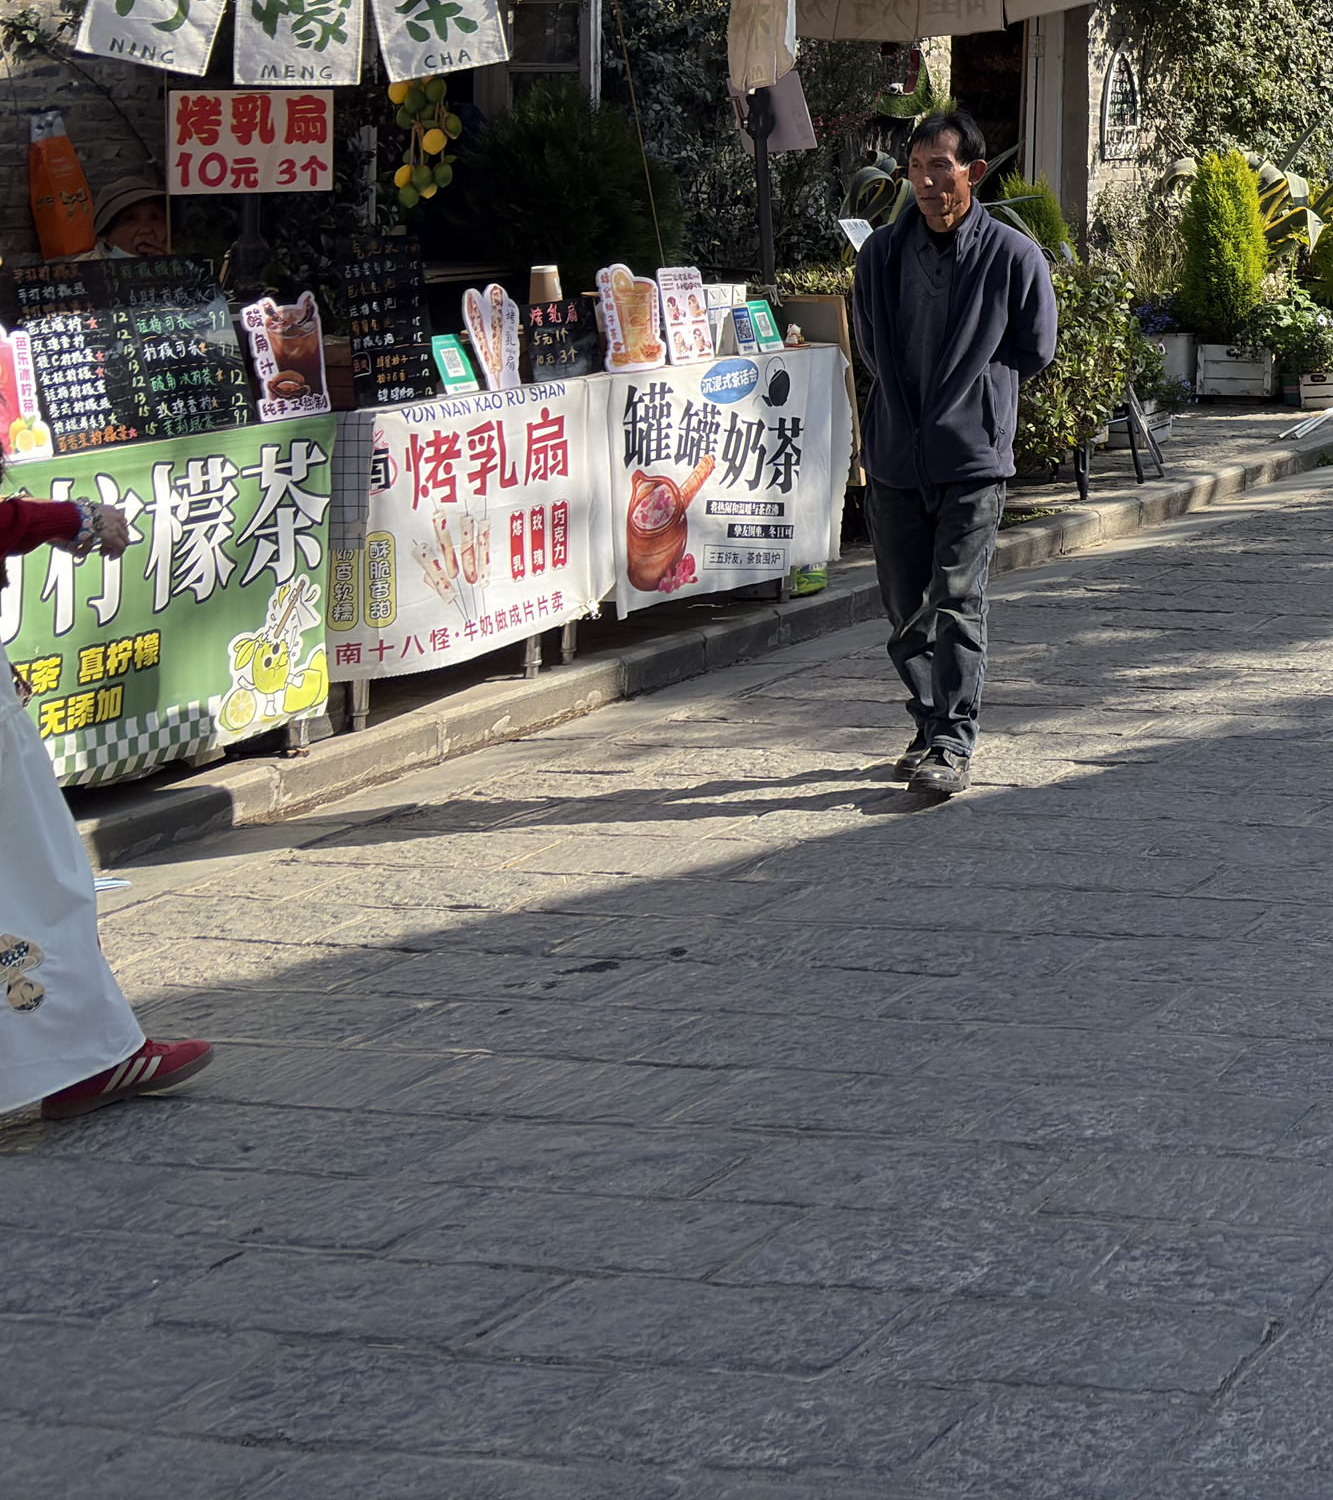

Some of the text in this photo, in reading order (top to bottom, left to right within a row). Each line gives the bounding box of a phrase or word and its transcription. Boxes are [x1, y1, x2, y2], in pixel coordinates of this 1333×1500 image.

[109, 38, 472, 80] NING MENG CHA
[176, 94, 328, 147] 烤乳扇
[175, 152, 328, 189] 10元 3个
[245, 308, 275, 376] 酸角汁
[529, 303, 579, 328] 烤乳扇
[401, 383, 566, 425] YUN NAN KAO RU SHAN
[702, 368, 758, 394] 沉浸式茶话会
[405, 407, 569, 510] 烤乳扇
[623, 381, 804, 495] 罐罐奶茶
[553, 508, 566, 560] 巧克力
[368, 540, 392, 620] 酥脆香甜
[78, 630, 161, 686] 真柠檬
[40, 684, 124, 737] 无添加
